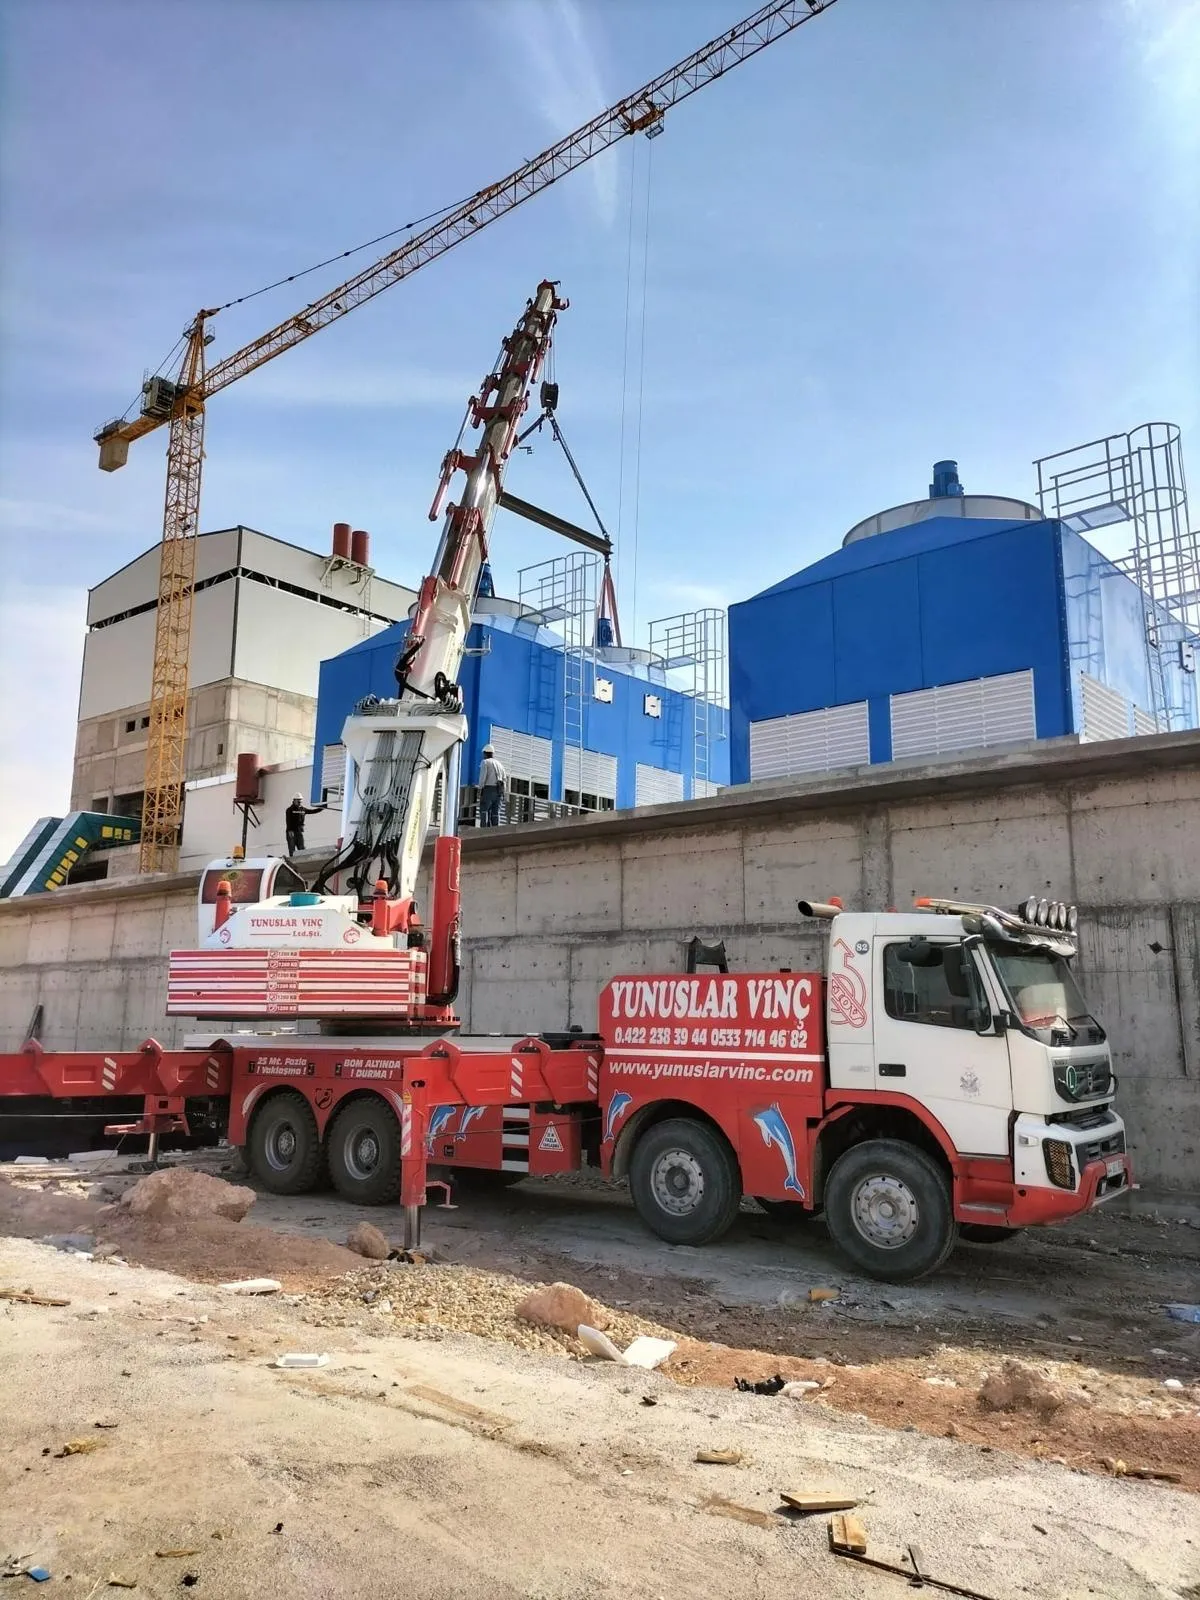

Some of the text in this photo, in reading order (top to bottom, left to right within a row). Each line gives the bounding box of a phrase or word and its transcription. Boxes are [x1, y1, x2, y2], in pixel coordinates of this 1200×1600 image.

[250, 919, 297, 927] YUNUSLAR
[856, 943, 868, 952] 82
[611, 980, 737, 1019] YUNUSLAR
[614, 1027, 807, 1049] 0.422 238 39 44 0533 714 46 82
[344, 1059, 363, 1067] BOM
[356, 1069, 386, 1078] DURMA
[609, 1061, 814, 1083] www.yunuslarvinc.com
